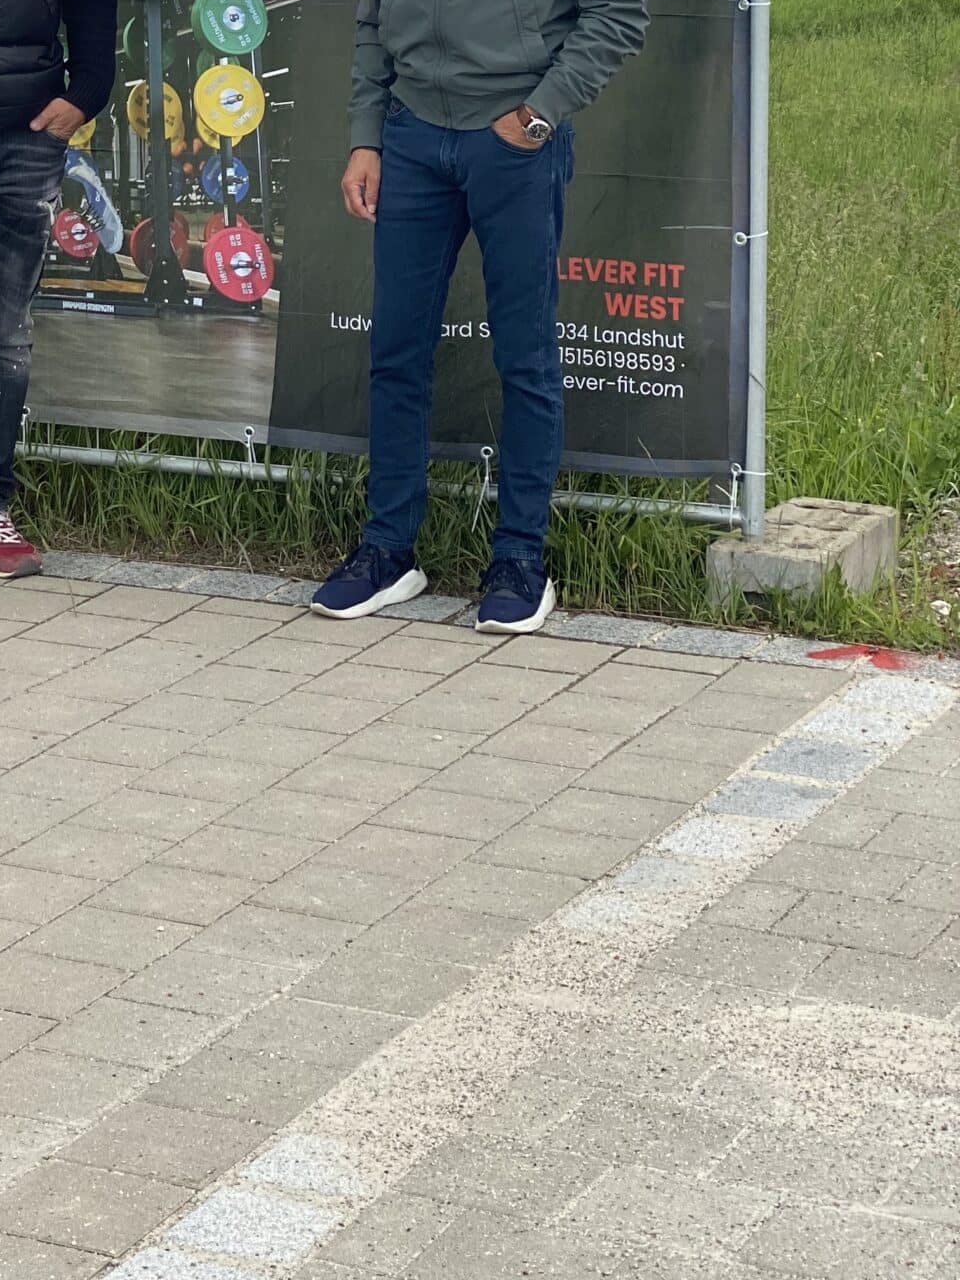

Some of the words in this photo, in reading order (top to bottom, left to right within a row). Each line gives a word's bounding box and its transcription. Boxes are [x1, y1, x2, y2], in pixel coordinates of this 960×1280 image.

[556, 257, 637, 285] LEVER
[644, 262, 686, 289] FIT
[604, 292, 685, 320] WEST
[330, 312, 373, 331] Ludw
[441, 321, 472, 338] ard
[479, 322, 490, 338] S
[556, 322, 589, 341] 034
[594, 326, 685, 349] Landshut
[558, 347, 676, 373] 15156198593
[563, 375, 684, 399] ever-fit.com
